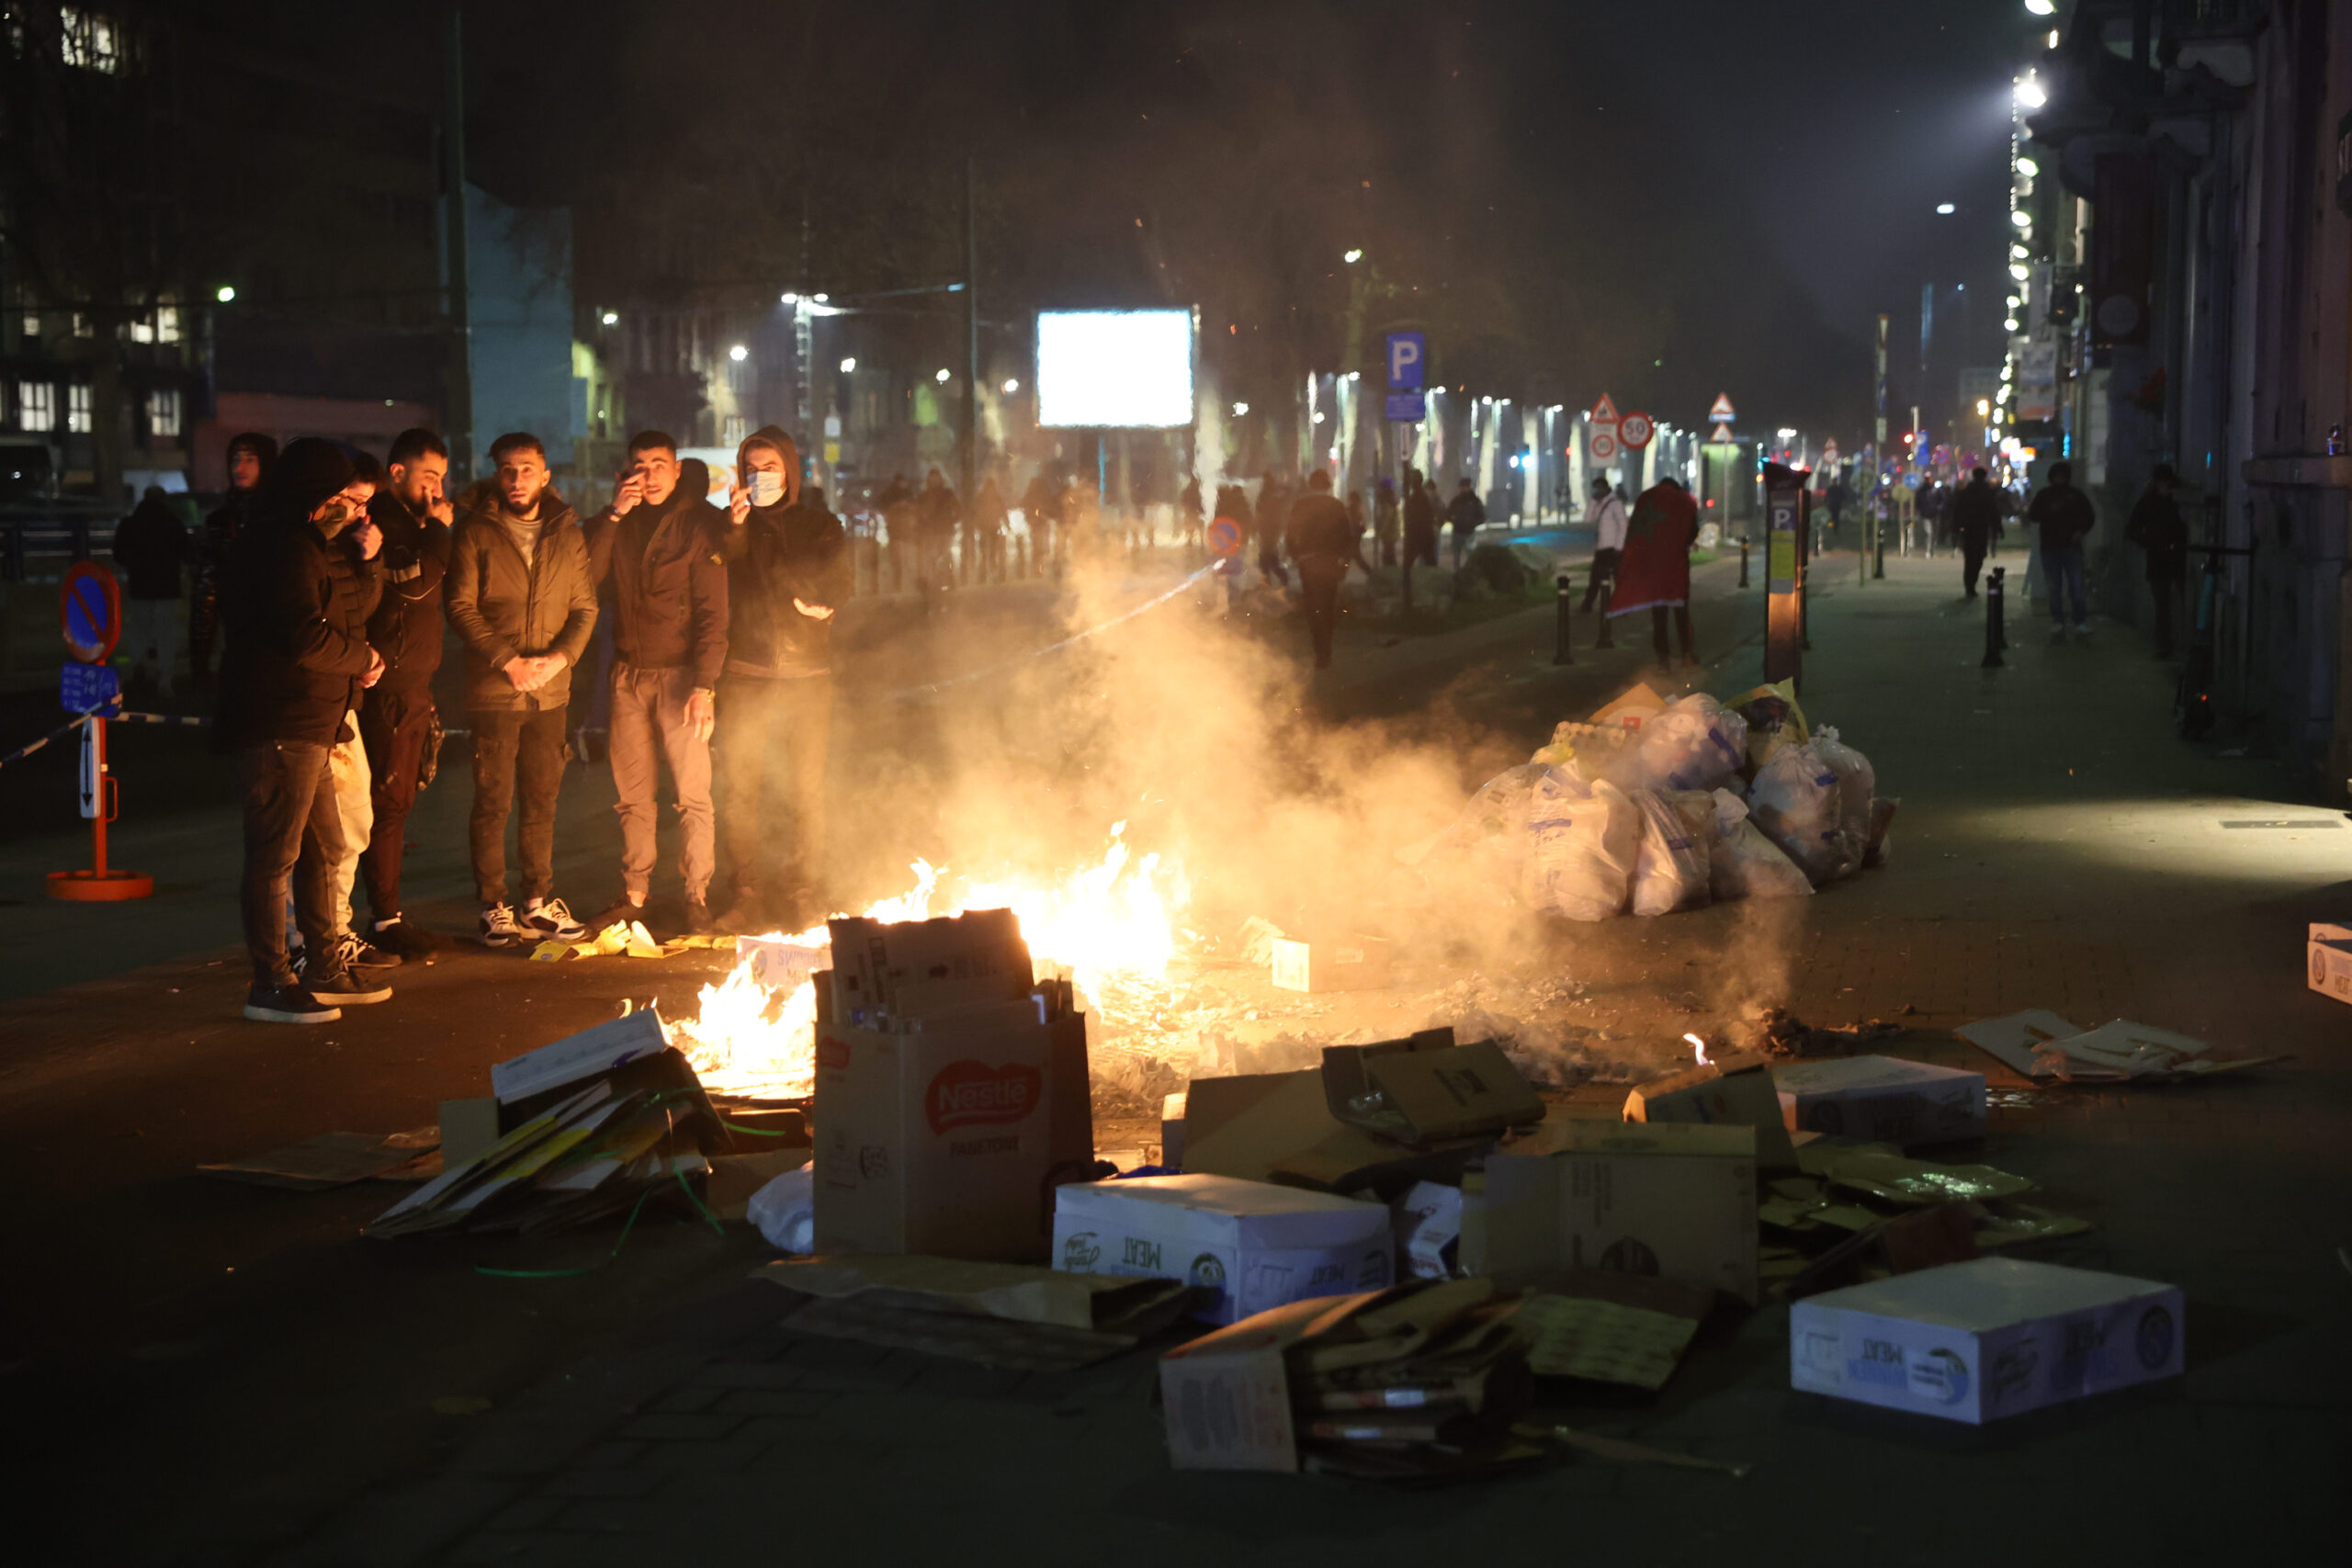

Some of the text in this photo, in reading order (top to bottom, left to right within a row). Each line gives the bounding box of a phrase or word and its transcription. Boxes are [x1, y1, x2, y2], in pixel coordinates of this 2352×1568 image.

[1392, 339, 1419, 381] P
[1624, 419, 1645, 435] 50
[1773, 508, 1791, 529] P
[938, 1077, 1028, 1111] Nestlé
[1122, 1236, 1161, 1270] MEAT
[1862, 1337, 1904, 1365] MEAT
